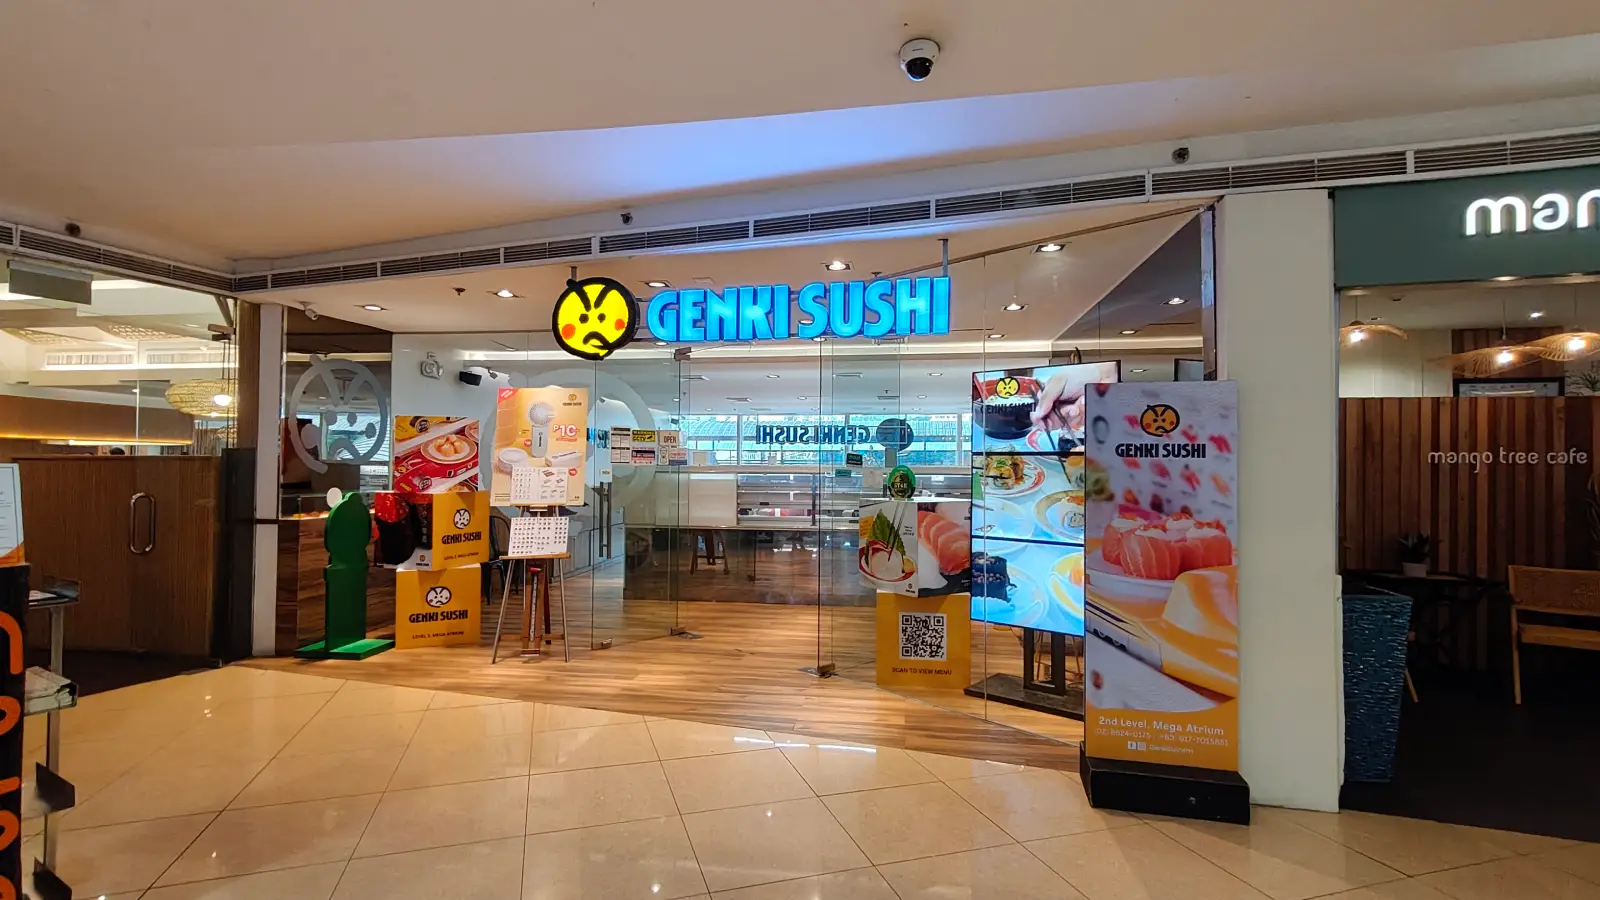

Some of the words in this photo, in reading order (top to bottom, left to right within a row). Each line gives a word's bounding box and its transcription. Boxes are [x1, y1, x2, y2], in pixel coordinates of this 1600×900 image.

[647, 284, 791, 342] GENKI
[798, 275, 950, 338] SUSHI
[663, 435, 677, 444] OPEN
[1115, 443, 1159, 458] GENKI
[1162, 443, 1206, 459] SUSHI
[1428, 451, 1493, 473] mango
[1499, 447, 1539, 464] tree
[1547, 448, 1588, 464] cafe
[441, 533, 462, 545] GENKI
[463, 531, 482, 543] SUSHI
[409, 611, 438, 623] GENKI
[440, 609, 468, 621] SUSHI
[1099, 716, 1118, 726] 2nd
[1153, 720, 1182, 733] Mega
[1186, 723, 1224, 736] Atrium
